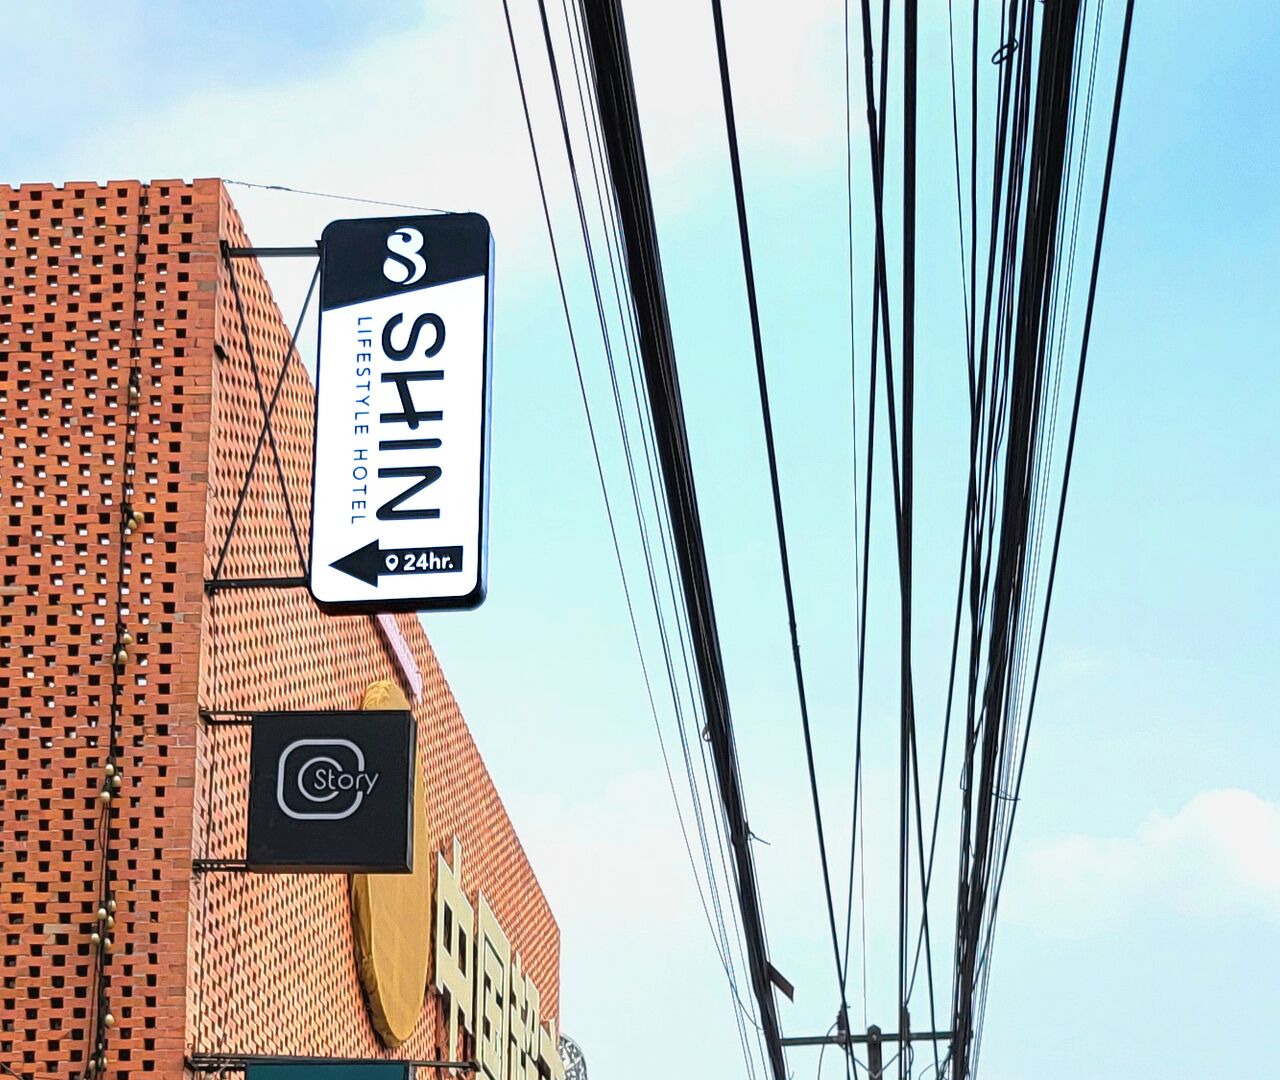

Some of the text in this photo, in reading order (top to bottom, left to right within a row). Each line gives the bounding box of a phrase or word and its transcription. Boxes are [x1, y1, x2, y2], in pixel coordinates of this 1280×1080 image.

[350, 316, 373, 526] LIFESTYLE HOTEL
[376, 311, 446, 522] SHIN
[402, 551, 455, 572] 24hr.
[314, 768, 379, 796] Story
